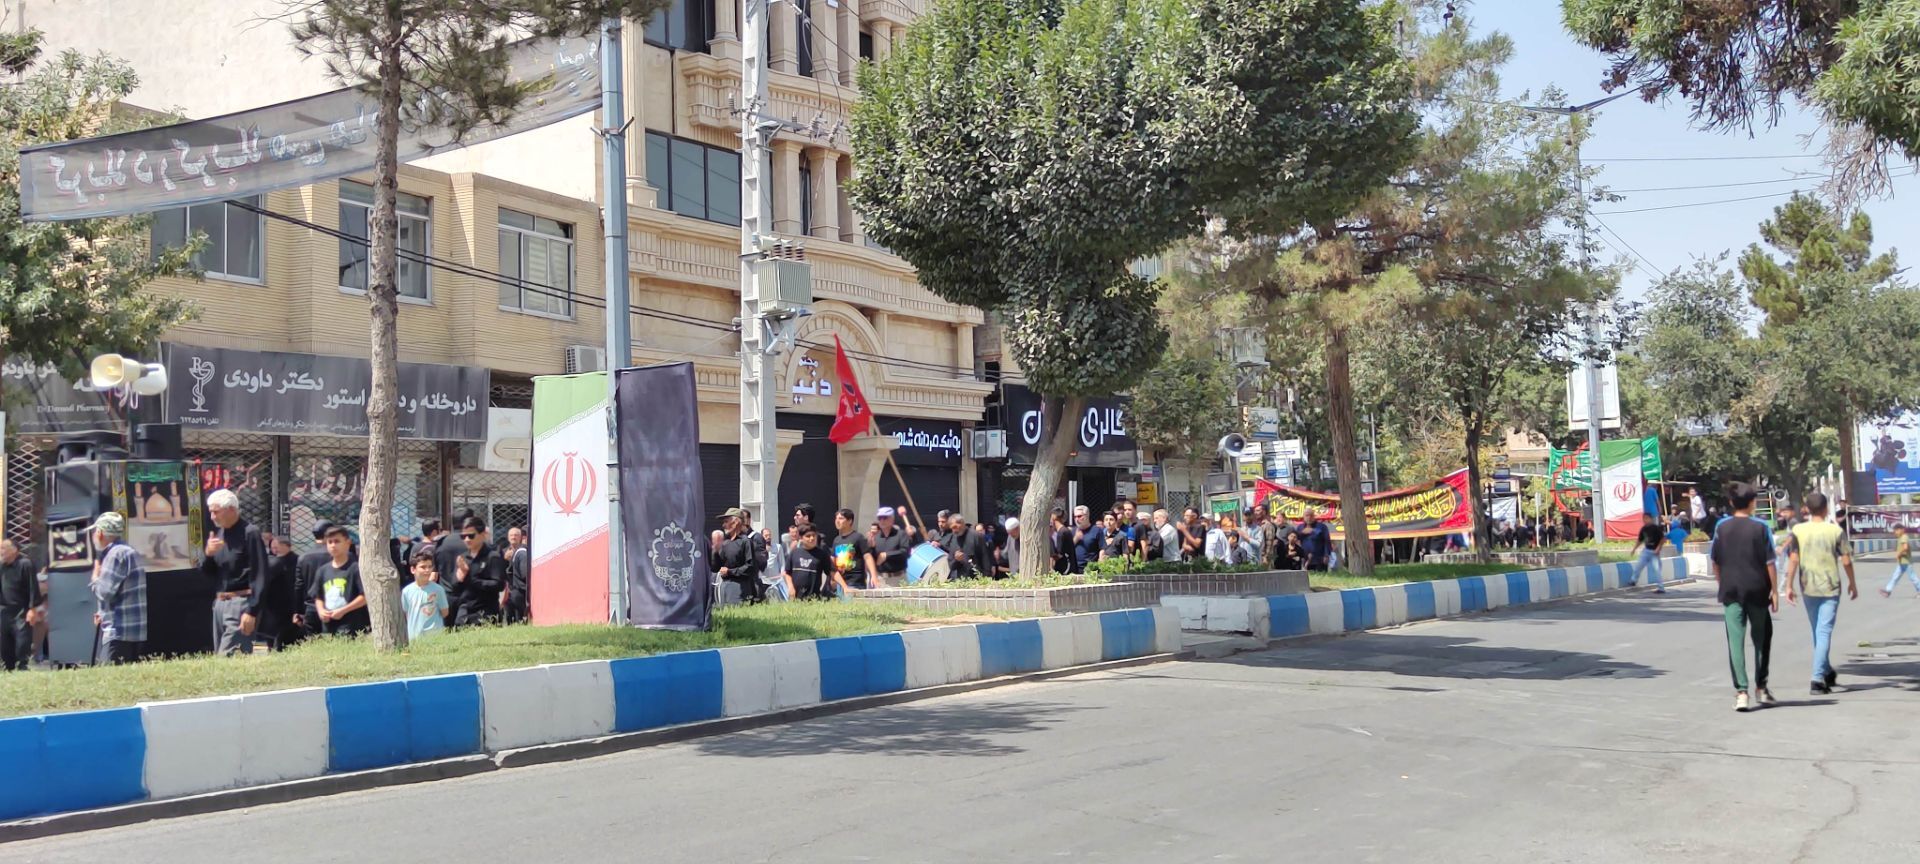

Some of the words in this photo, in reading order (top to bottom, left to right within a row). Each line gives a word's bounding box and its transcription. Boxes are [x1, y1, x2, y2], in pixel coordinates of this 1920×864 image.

[224, 368, 273, 394] داودی
[276, 372, 324, 394] دکتر
[792, 370, 832, 403] دنی
[322, 388, 366, 409] استور
[407, 400, 417, 413] و
[420, 391, 477, 416] داروخانه
